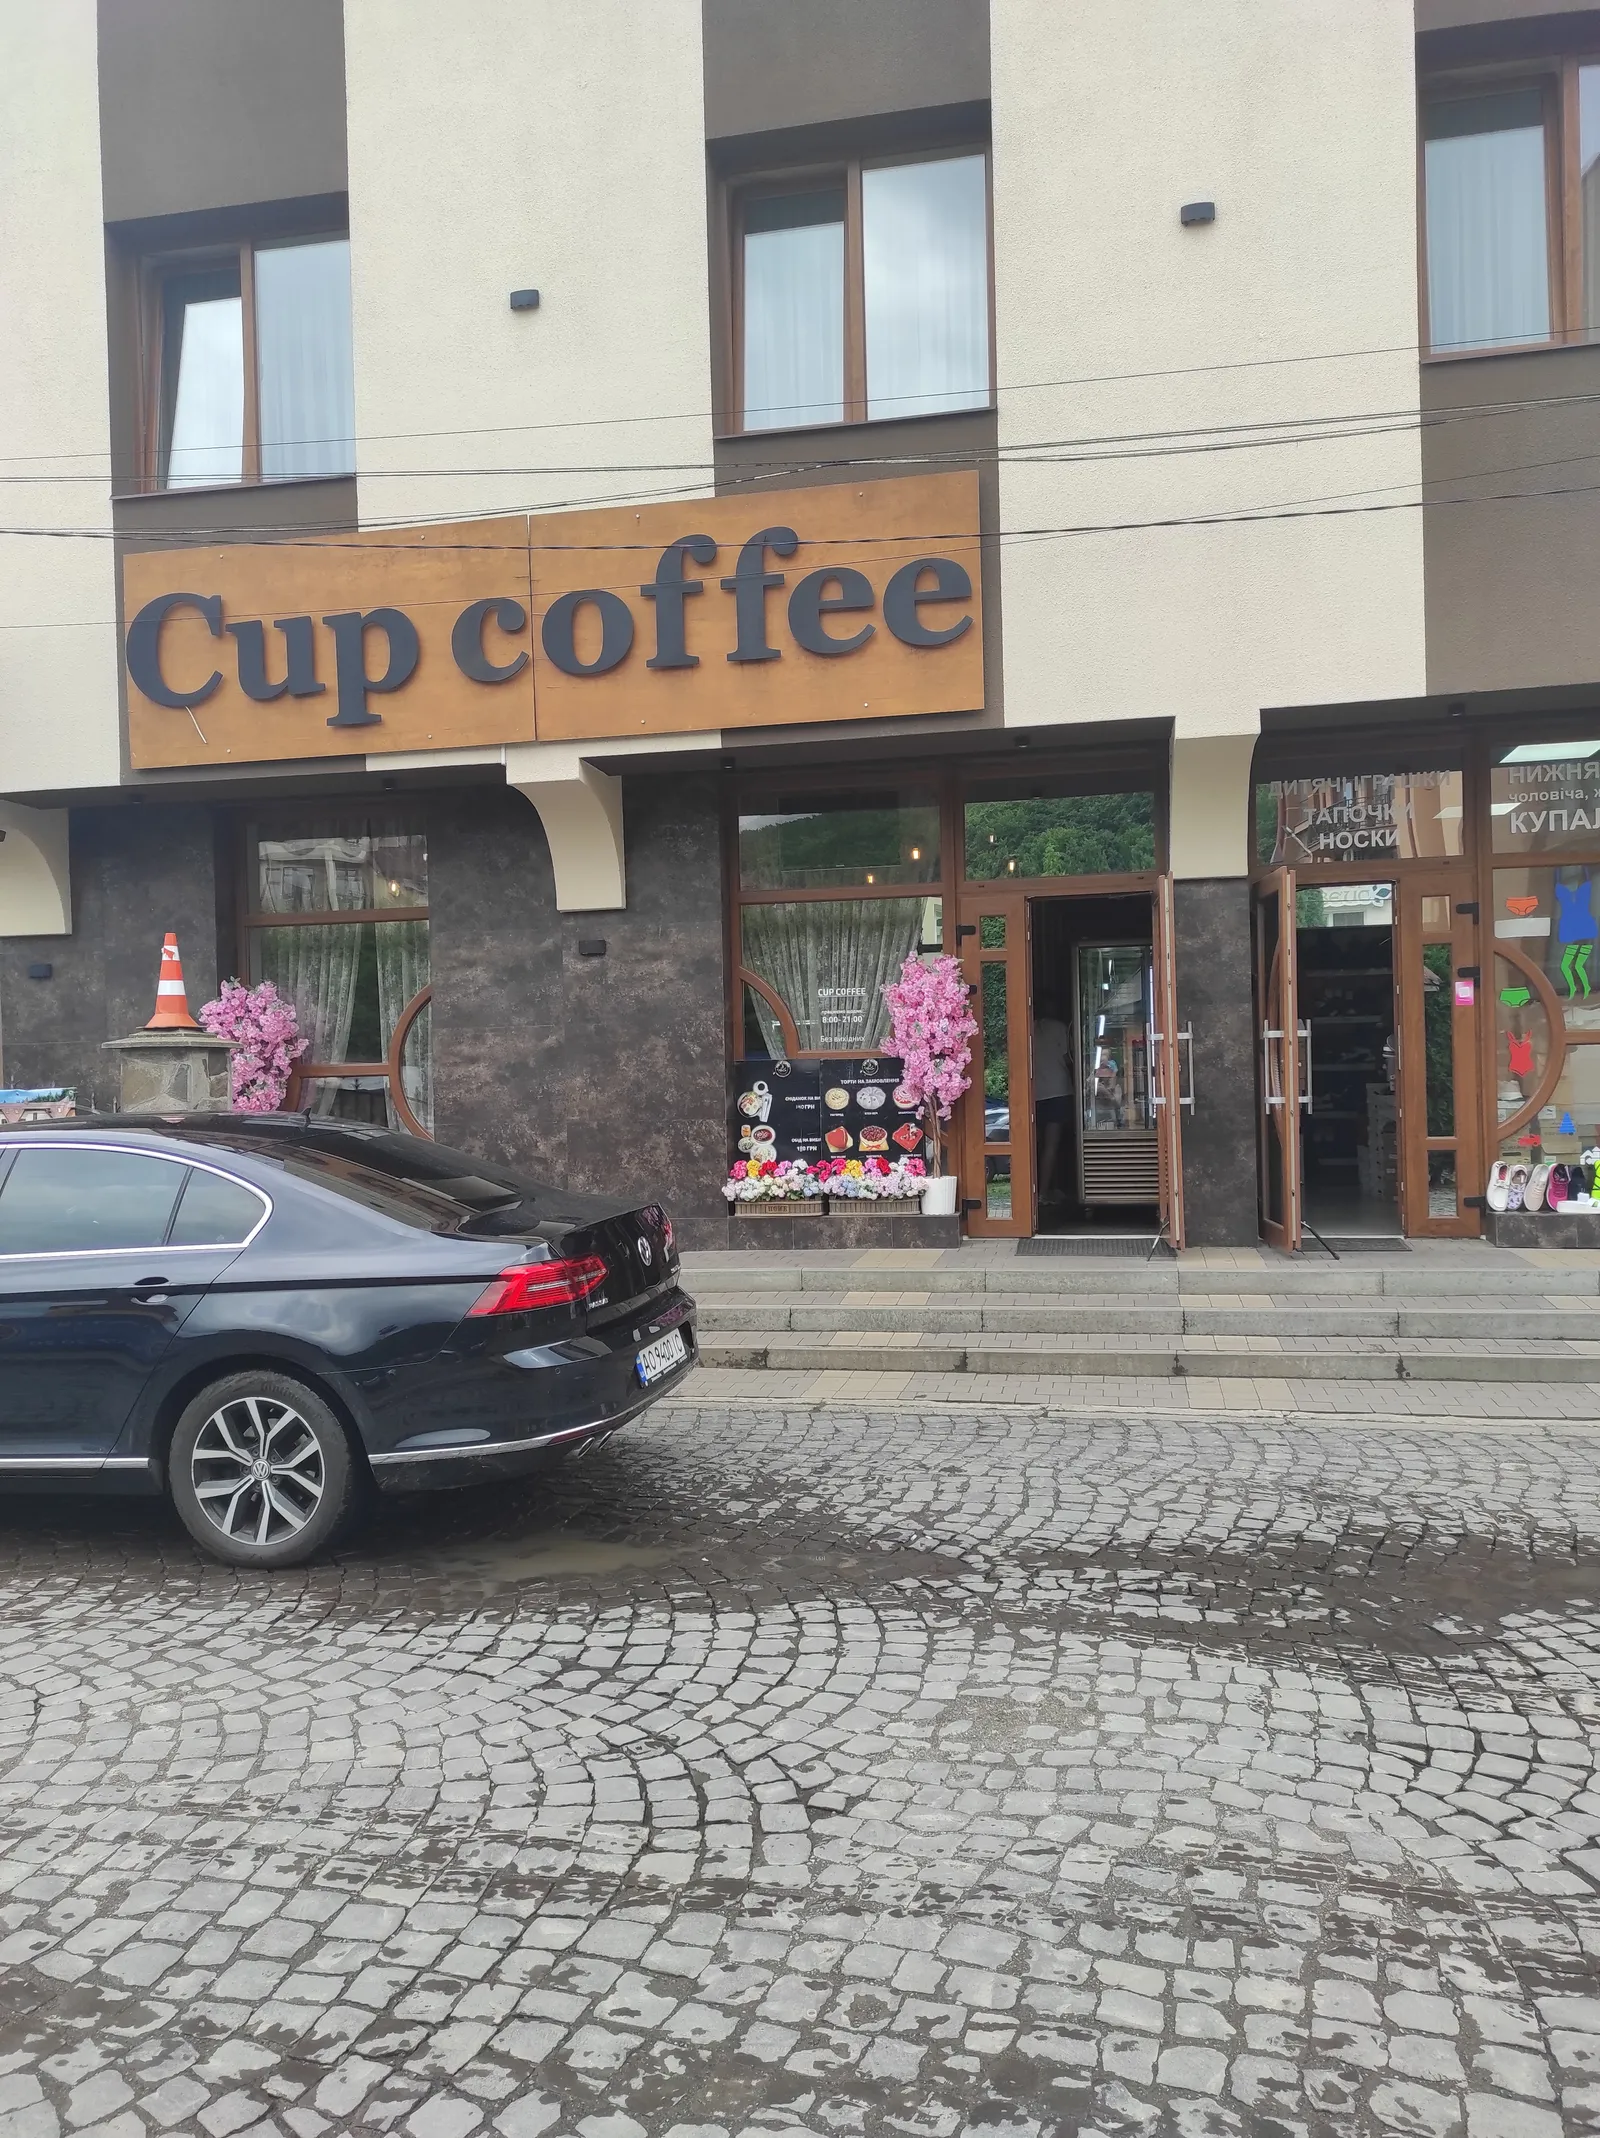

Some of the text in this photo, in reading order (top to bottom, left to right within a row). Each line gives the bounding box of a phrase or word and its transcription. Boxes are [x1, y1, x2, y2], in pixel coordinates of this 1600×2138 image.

[126, 525, 974, 727] Cup coffee
[1509, 761, 1600, 784] НИЖНЯ
[1270, 769, 1451, 800] ДИТЯЧІ ІГРАШКИ
[1508, 788, 1589, 803] чоловіча,
[1303, 802, 1413, 826] ТАПОЧКИ
[1319, 828, 1401, 850] НОСКИ
[817, 987, 867, 996] CUP COFFEE
[820, 1035, 833, 1043] Без
